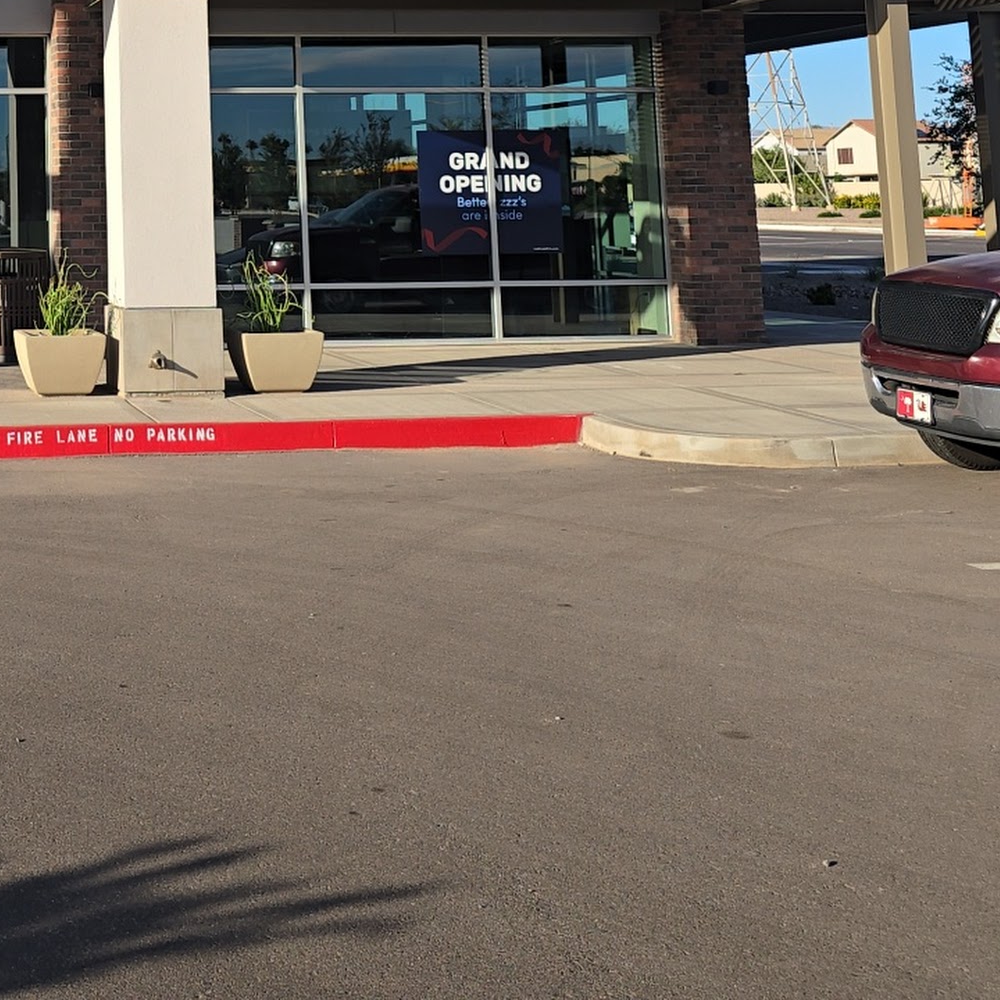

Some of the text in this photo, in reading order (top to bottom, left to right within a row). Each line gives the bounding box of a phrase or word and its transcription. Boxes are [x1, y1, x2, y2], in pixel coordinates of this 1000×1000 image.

[448, 151, 531, 171] GRAND
[439, 173, 542, 194] OPENING
[456, 195, 527, 208] Bette zzz's
[461, 211, 482, 221] are
[6, 427, 216, 446] FIRE LANE NO PARKING
